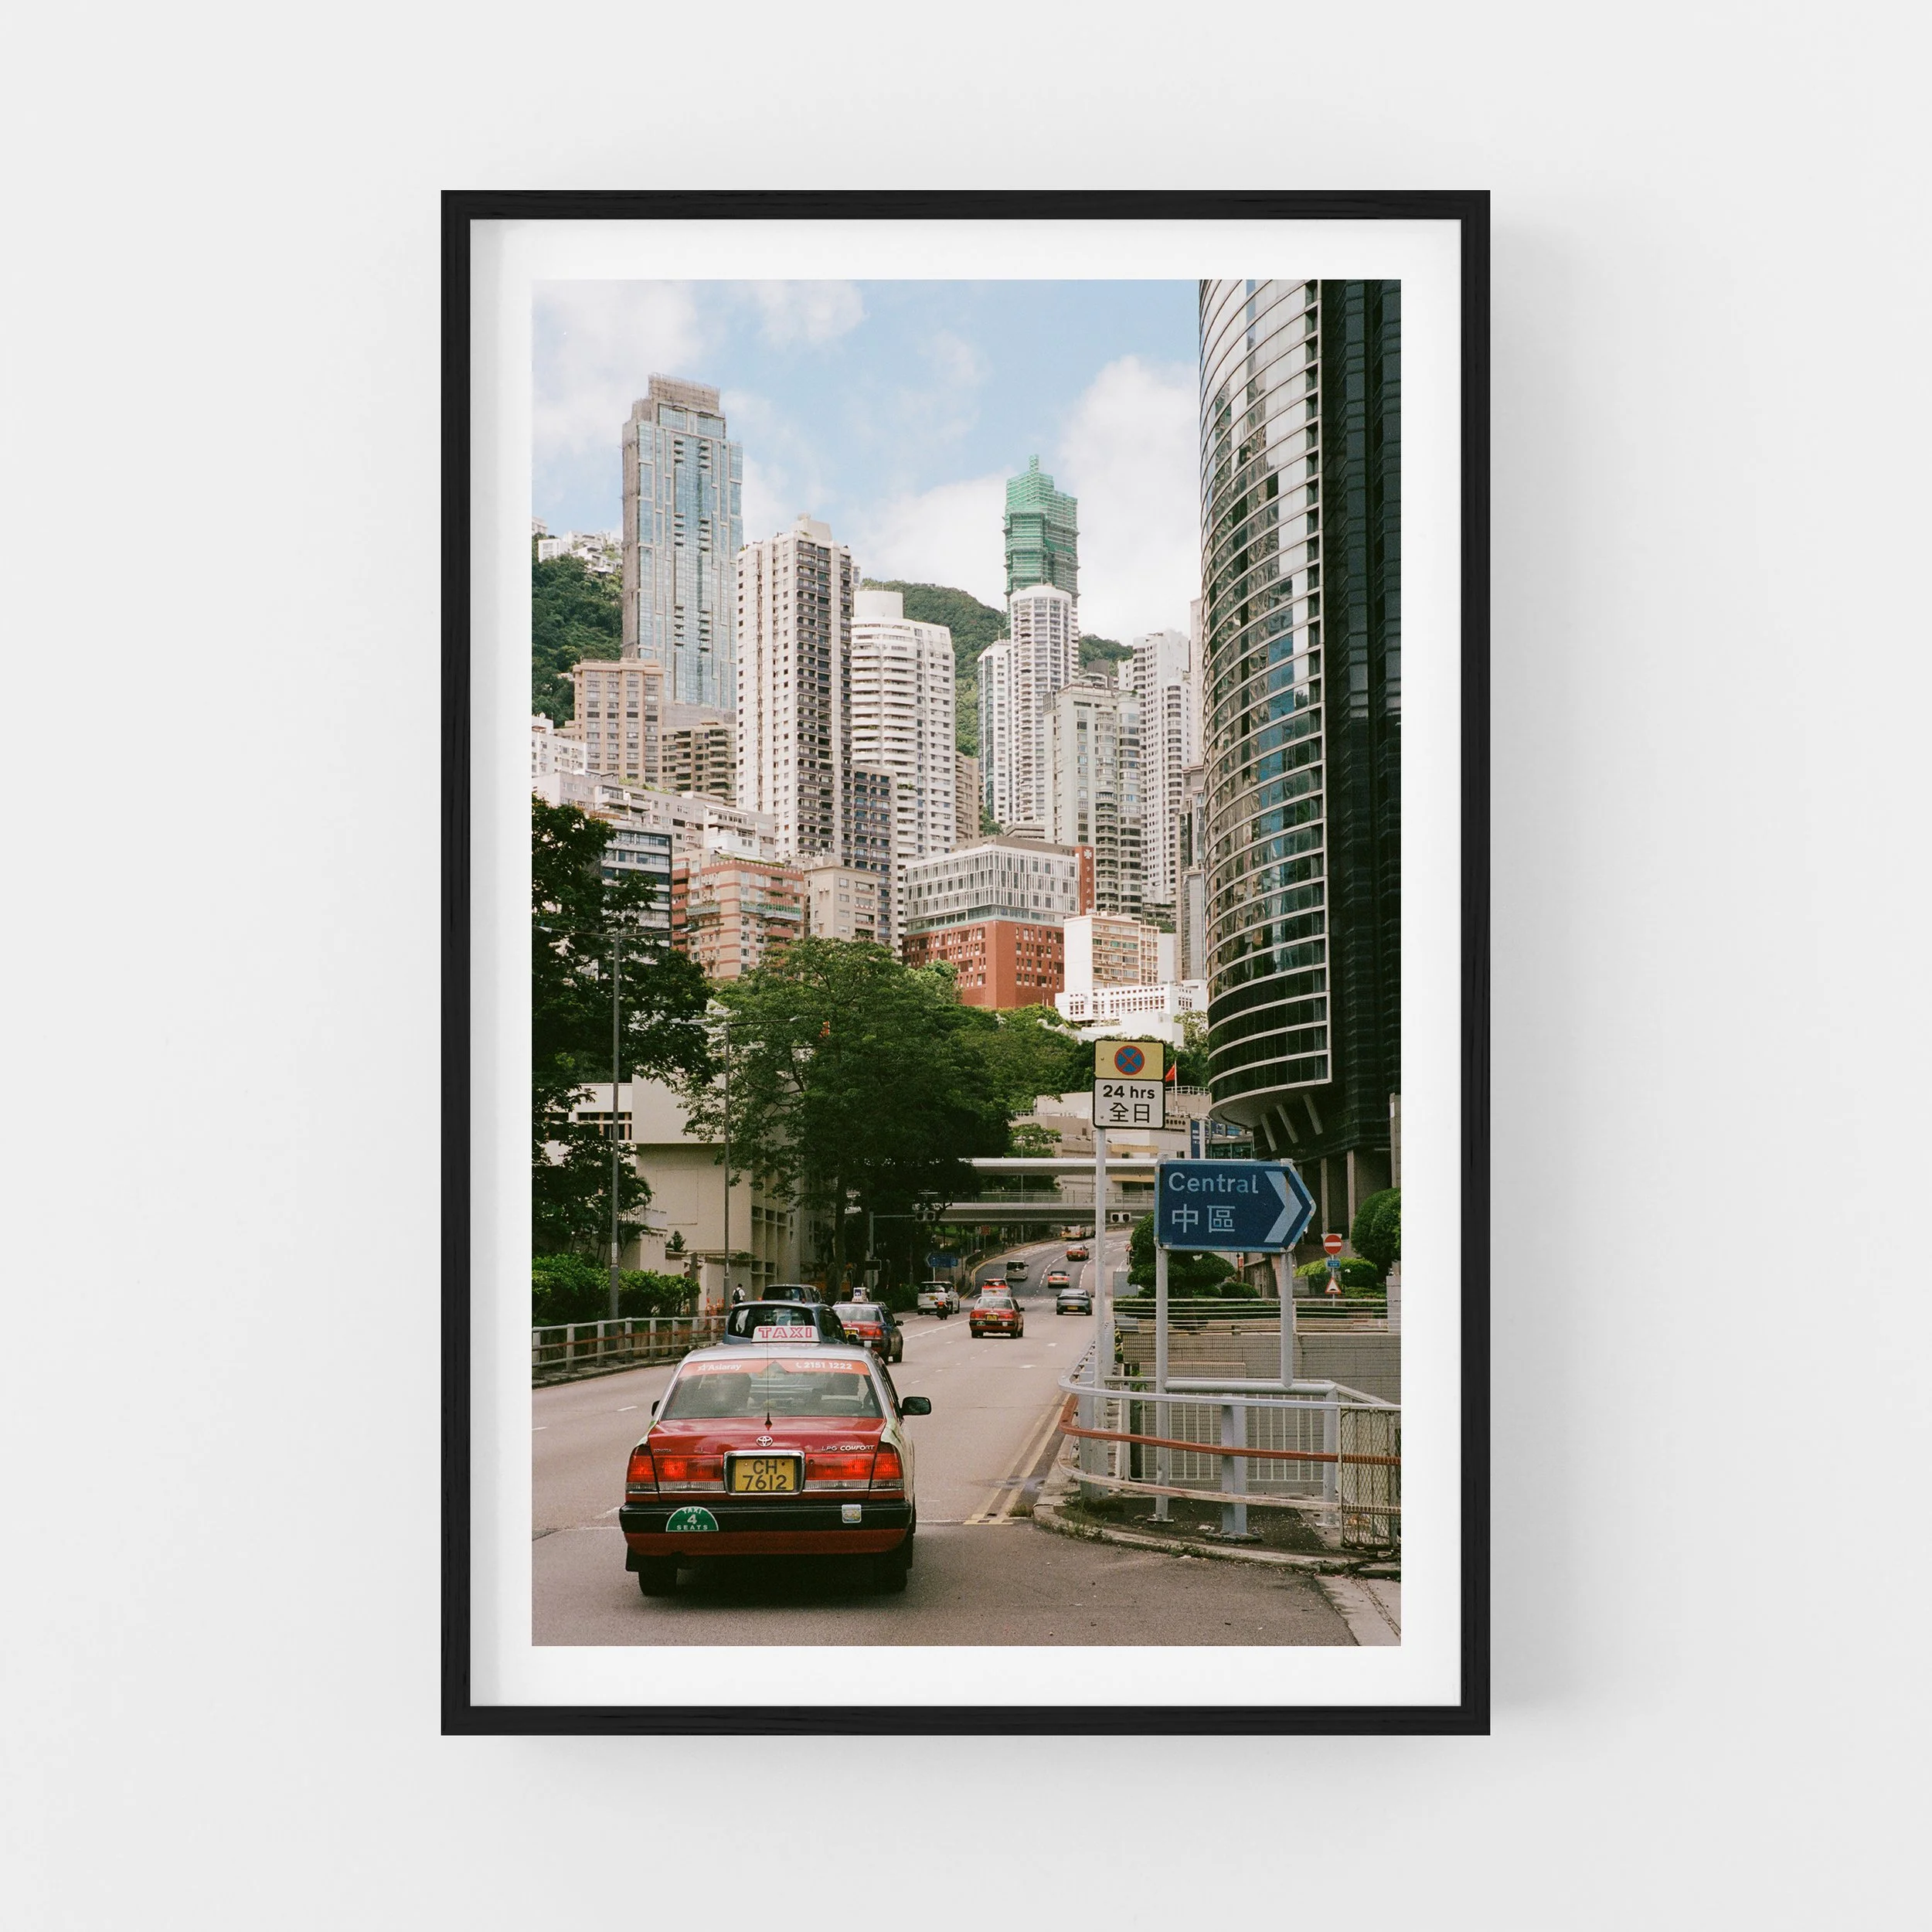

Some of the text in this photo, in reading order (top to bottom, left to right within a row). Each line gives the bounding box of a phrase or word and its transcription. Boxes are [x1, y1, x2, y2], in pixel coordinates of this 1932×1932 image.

[1103, 1085, 1155, 1099] 24 hrs
[1109, 1102, 1151, 1123] 全日
[1168, 1172, 1259, 1194] Central
[1172, 1203, 1236, 1233] 中區
[758, 1327, 813, 1338] TAXI
[708, 1363, 742, 1372] Asiaray
[828, 1362, 853, 1370] 1222
[753, 1459, 777, 1475] CH
[743, 1475, 787, 1490] 7612
[687, 1514, 698, 1525] 4
